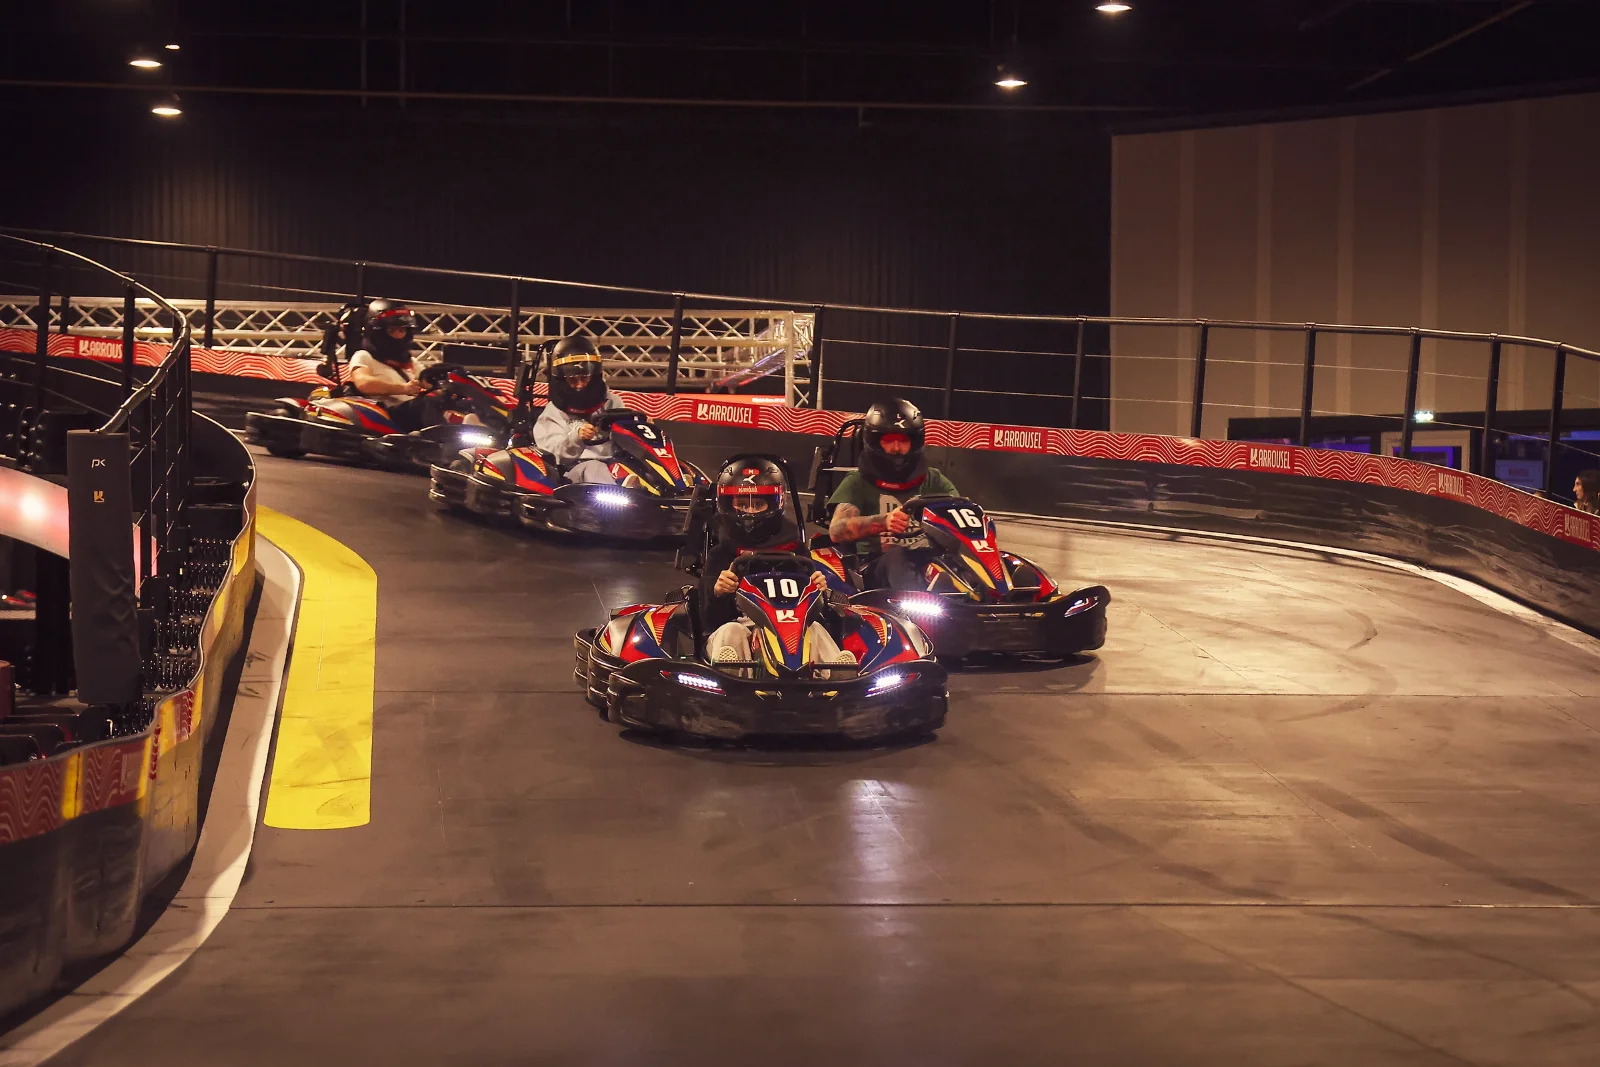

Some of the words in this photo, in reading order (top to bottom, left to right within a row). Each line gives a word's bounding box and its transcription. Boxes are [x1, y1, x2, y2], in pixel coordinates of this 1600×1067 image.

[79, 339, 123, 359] KARROUS
[637, 424, 657, 439] 3
[947, 508, 982, 528] 16
[763, 578, 799, 598] 10
